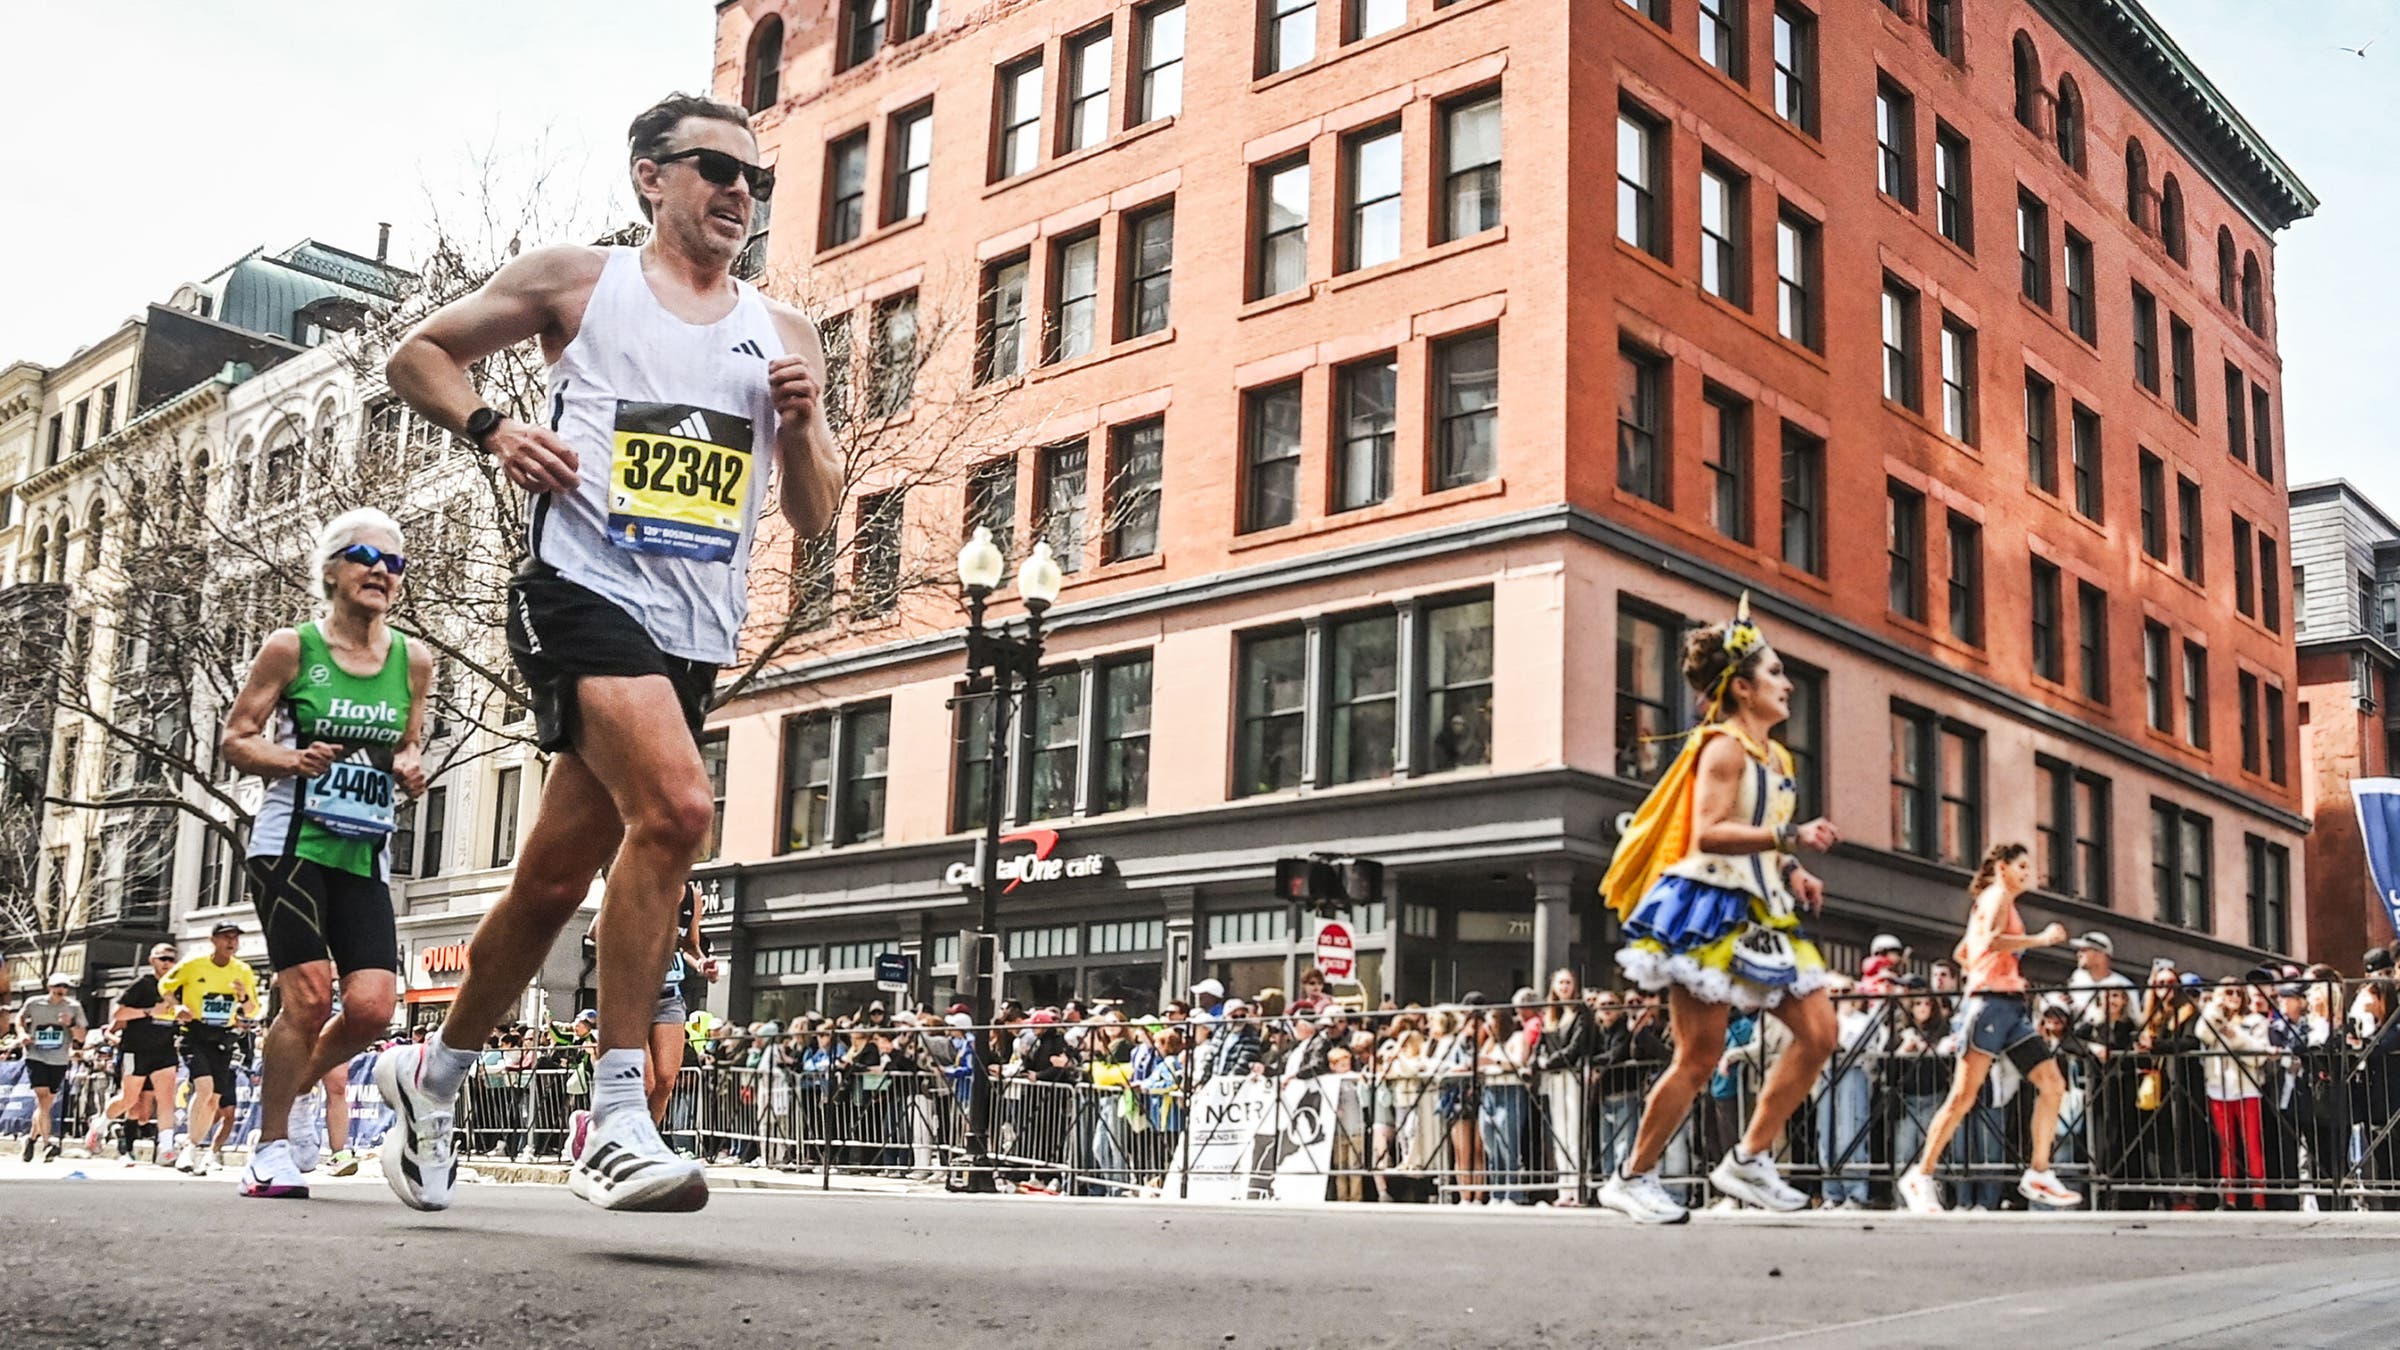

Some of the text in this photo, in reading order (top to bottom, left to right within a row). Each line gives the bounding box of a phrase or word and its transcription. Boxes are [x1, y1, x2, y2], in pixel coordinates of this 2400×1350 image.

[624, 438, 743, 507] 32342
[328, 699, 397, 724] Hayle
[313, 767, 389, 808] 24403
[1066, 854, 1103, 877] café
[1508, 920, 1531, 935] 711
